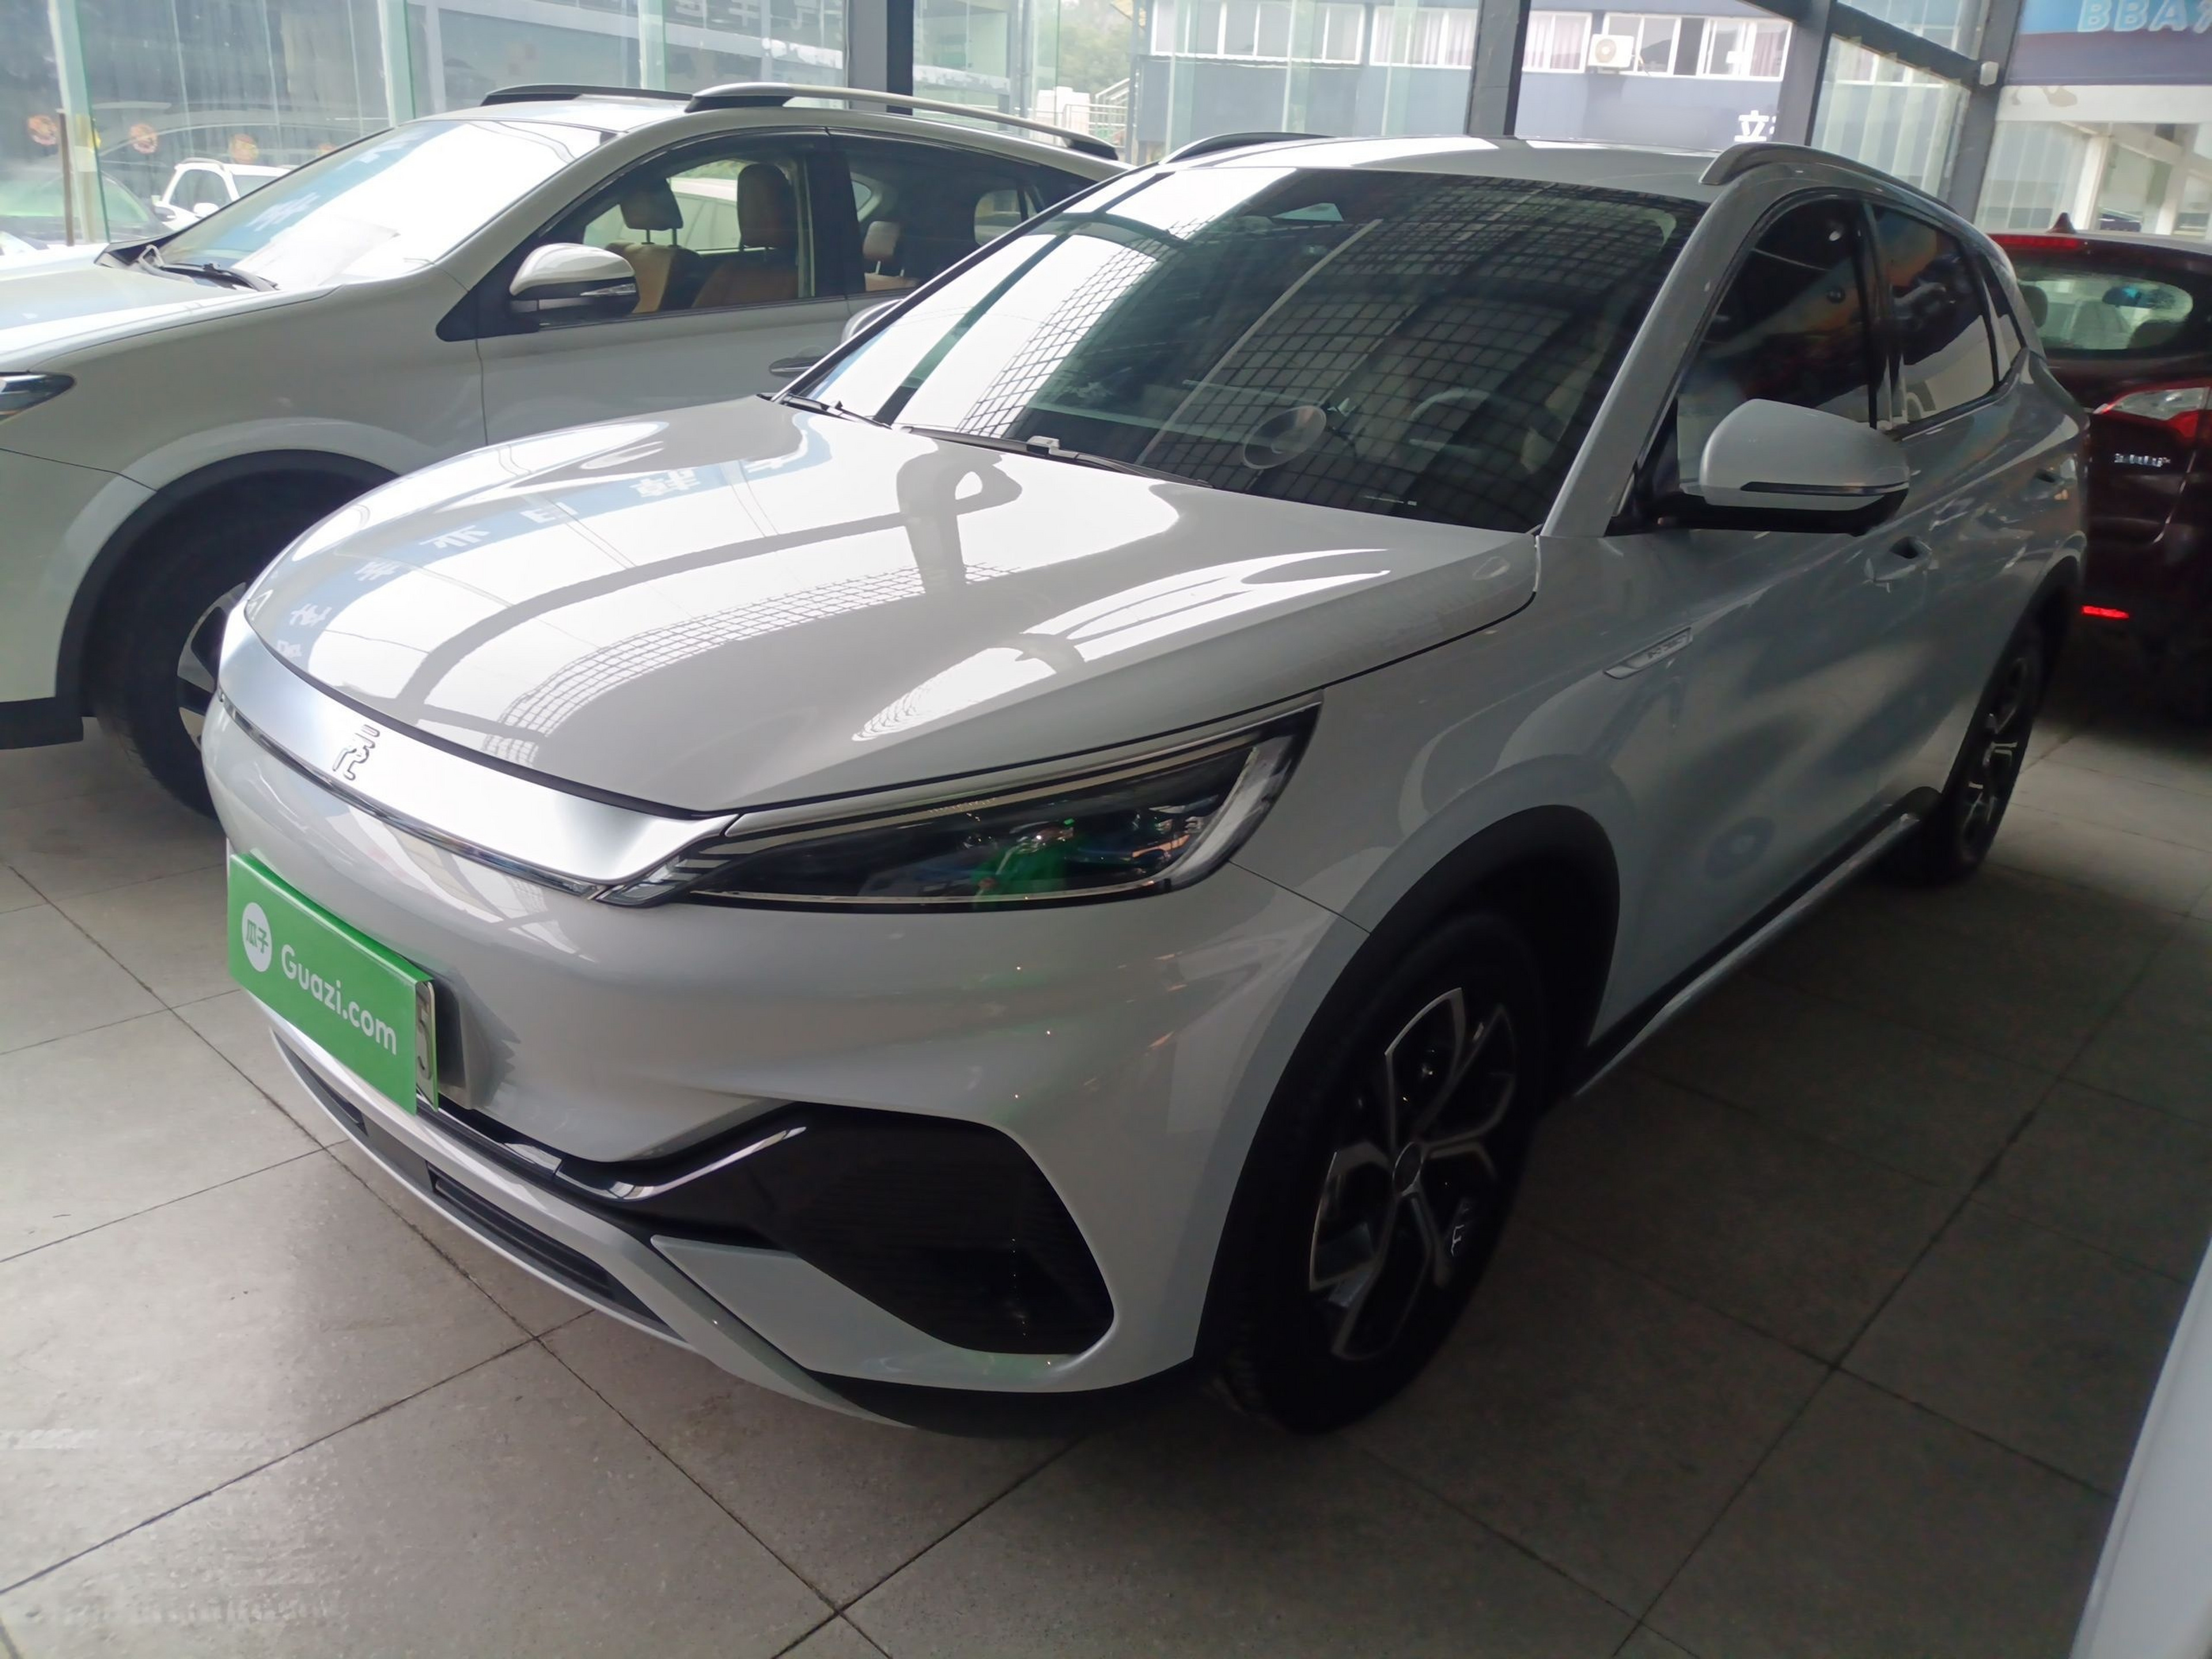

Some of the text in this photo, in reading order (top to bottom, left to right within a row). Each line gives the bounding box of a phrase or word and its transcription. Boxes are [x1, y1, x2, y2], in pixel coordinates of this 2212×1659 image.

[1734, 110, 1777, 142] 立
[247, 919, 269, 954] 瓜子
[281, 944, 397, 1056] Guazi.com
